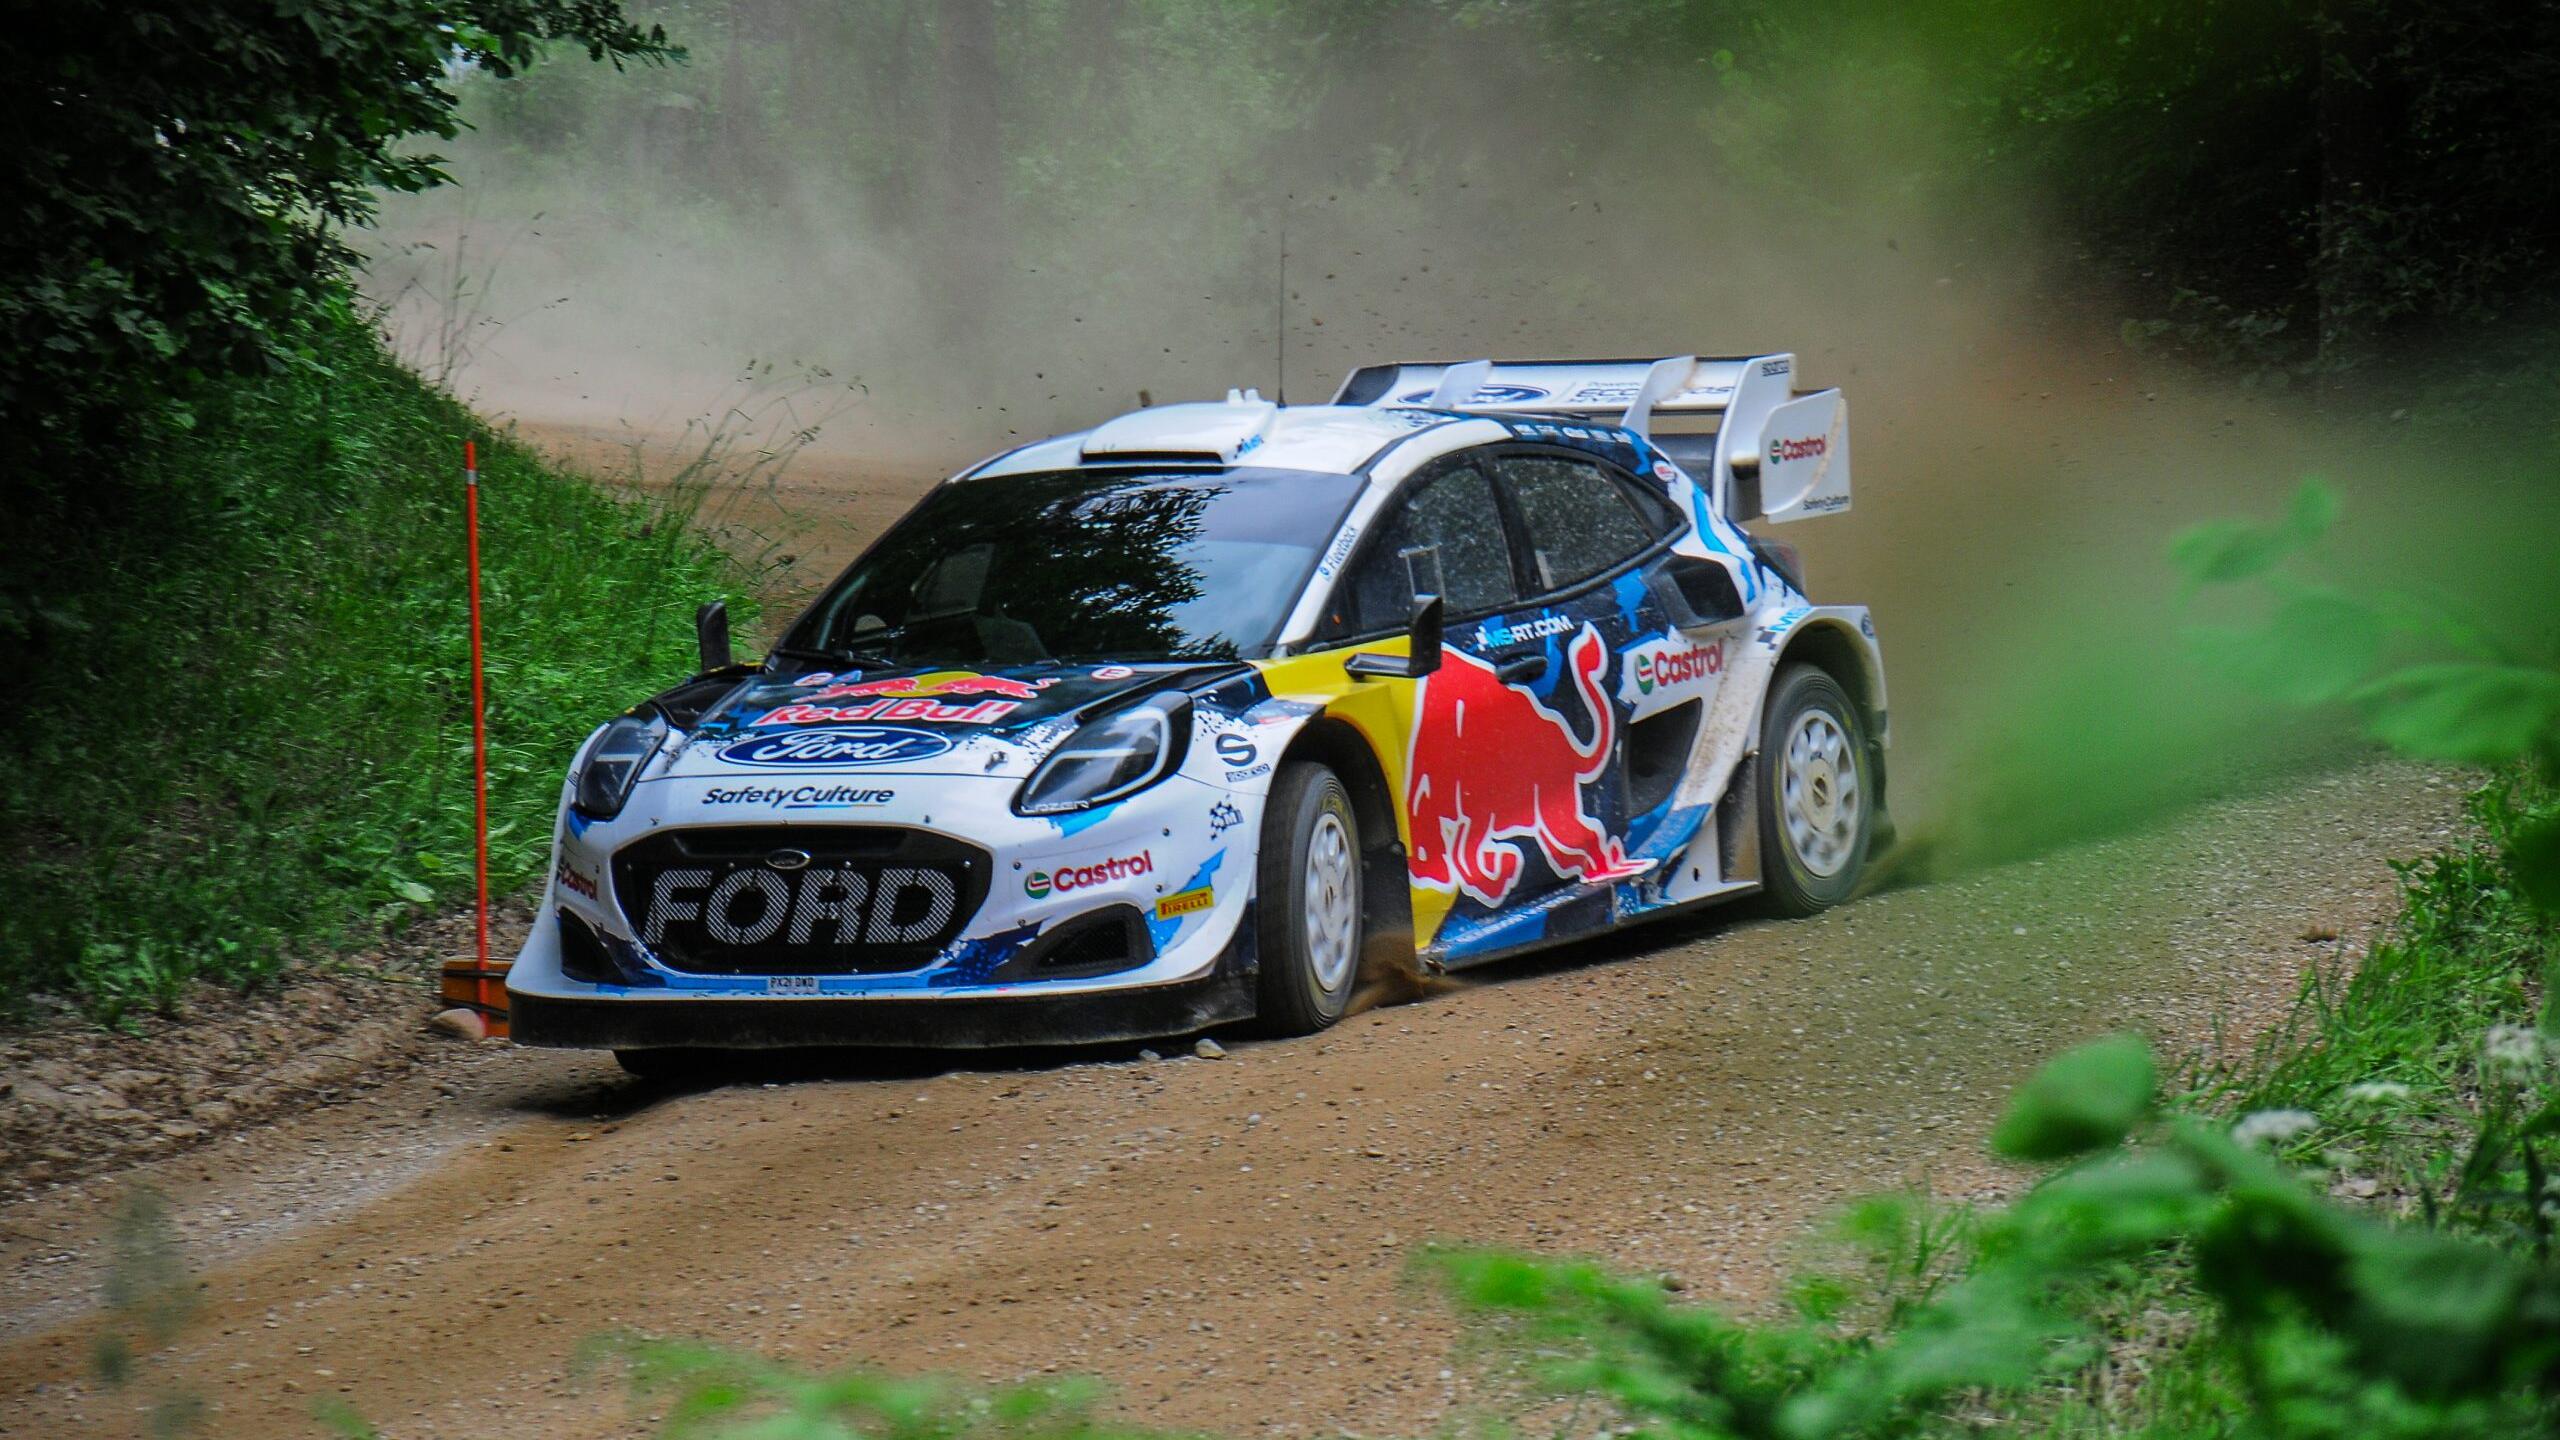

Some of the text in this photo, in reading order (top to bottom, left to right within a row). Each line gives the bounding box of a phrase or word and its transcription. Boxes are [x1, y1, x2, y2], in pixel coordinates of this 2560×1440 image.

[1783, 434, 1826, 461] Castrol
[1484, 614, 1575, 646] MS-RT.COM
[1653, 637, 1724, 688] Castrol
[754, 700, 1018, 724] Red Bull
[752, 731, 917, 760] Ford
[702, 786, 895, 808] SafetyCulture
[1053, 849, 1154, 892] Castrol
[643, 868, 958, 945] FORD
[1159, 893, 1209, 916] PIRELLI
